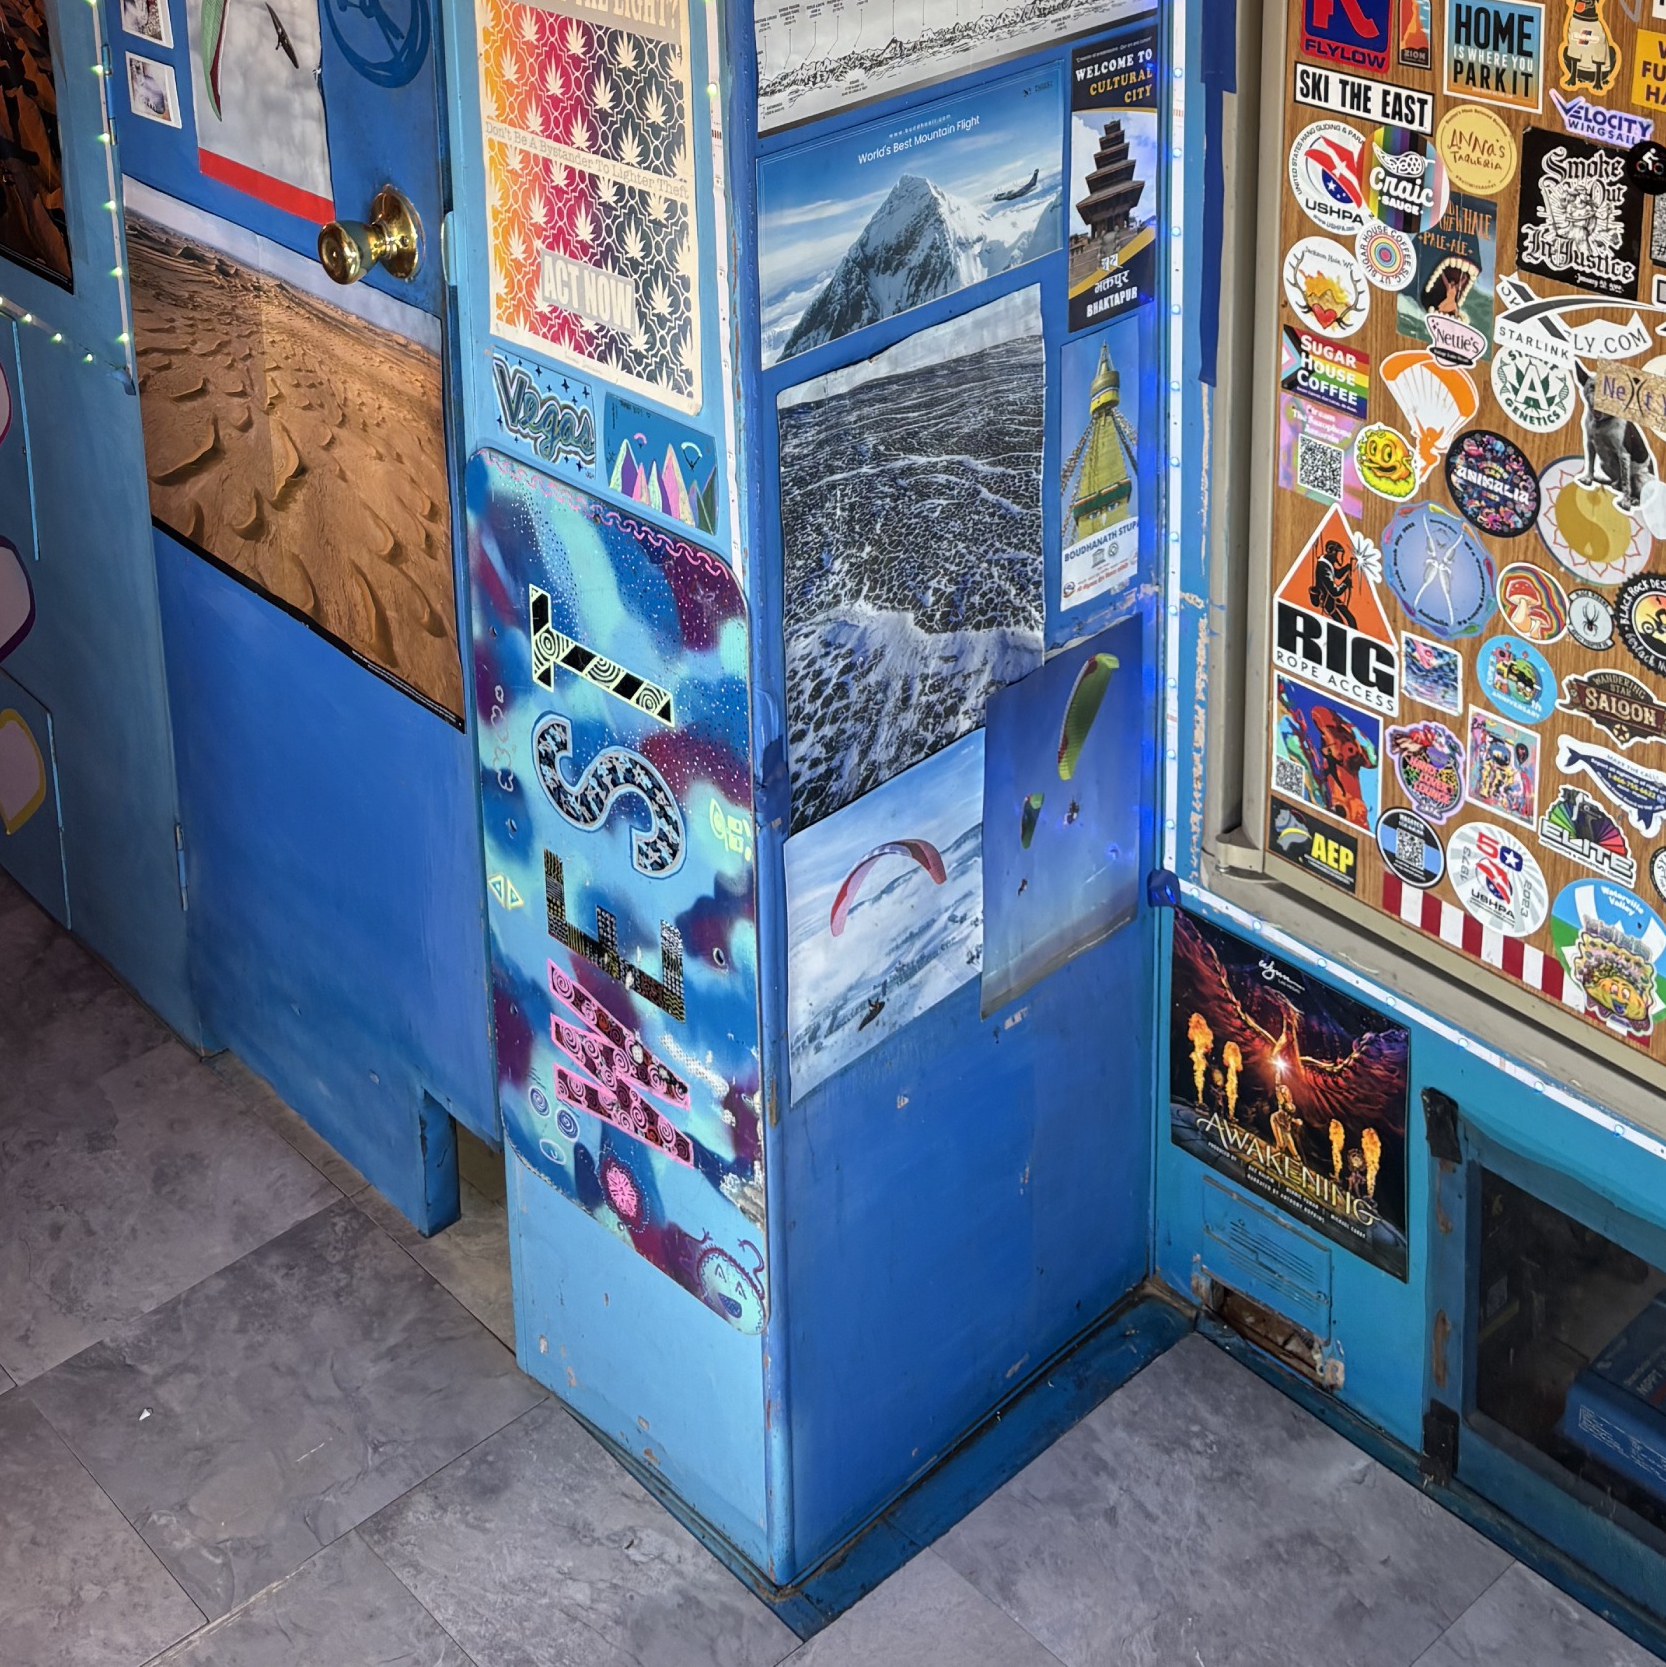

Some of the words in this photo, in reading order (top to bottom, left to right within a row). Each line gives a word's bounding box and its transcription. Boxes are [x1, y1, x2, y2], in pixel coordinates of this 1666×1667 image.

[1455, 3, 1534, 57] HOME
[1075, 55, 1134, 82] WELCOME
[1138, 50, 1153, 63] TO
[1304, 40, 1386, 70] FLYLOW
[1454, 45, 1465, 59] IS
[1468, 48, 1507, 67] WHERE
[1512, 55, 1533, 72] YOU
[1089, 68, 1153, 96] CULTURAL
[1124, 84, 1153, 104] CITY
[1299, 70, 1330, 104] SKI
[1339, 78, 1372, 115] THE
[1381, 91, 1429, 126] EAST
[857, 145, 892, 165] World's
[893, 139, 913, 156] Best
[914, 124, 954, 150] Mountain
[956, 114, 981, 134] Flight
[484, 120, 513, 144] Don't
[515, 130, 527, 149] Be
[529, 136, 538, 150] A
[540, 139, 592, 169] Bystander
[595, 156, 609, 172] To
[611, 160, 656, 191] Lighter
[656, 177, 689, 201] Theft
[1305, 198, 1365, 226] USHPA
[542, 255, 581, 309] ACT
[583, 270, 633, 330] NOW
[1086, 286, 1138, 318] BHAKTAPUR
[1300, 334, 1357, 369] SUGAR
[1499, 326, 1569, 360] STARLINK
[1297, 369, 1358, 406] COFFEE
[1301, 352, 1356, 386] HOUSE
[493, 354, 595, 462] Vegas
[1620, 593, 1633, 624] BLACK
[1628, 579, 1650, 597] ROCK
[1277, 603, 1395, 697] RIG
[1276, 650, 1319, 678] ROPE
[1327, 673, 1395, 712] ACCESS
[1610, 684, 1631, 697] STAR
[1311, 833, 1354, 875] AEP
[1460, 846, 1471, 881] 1973
[1521, 880, 1532, 917] 2023
[1197, 1112, 1382, 1226] AWAKENING
